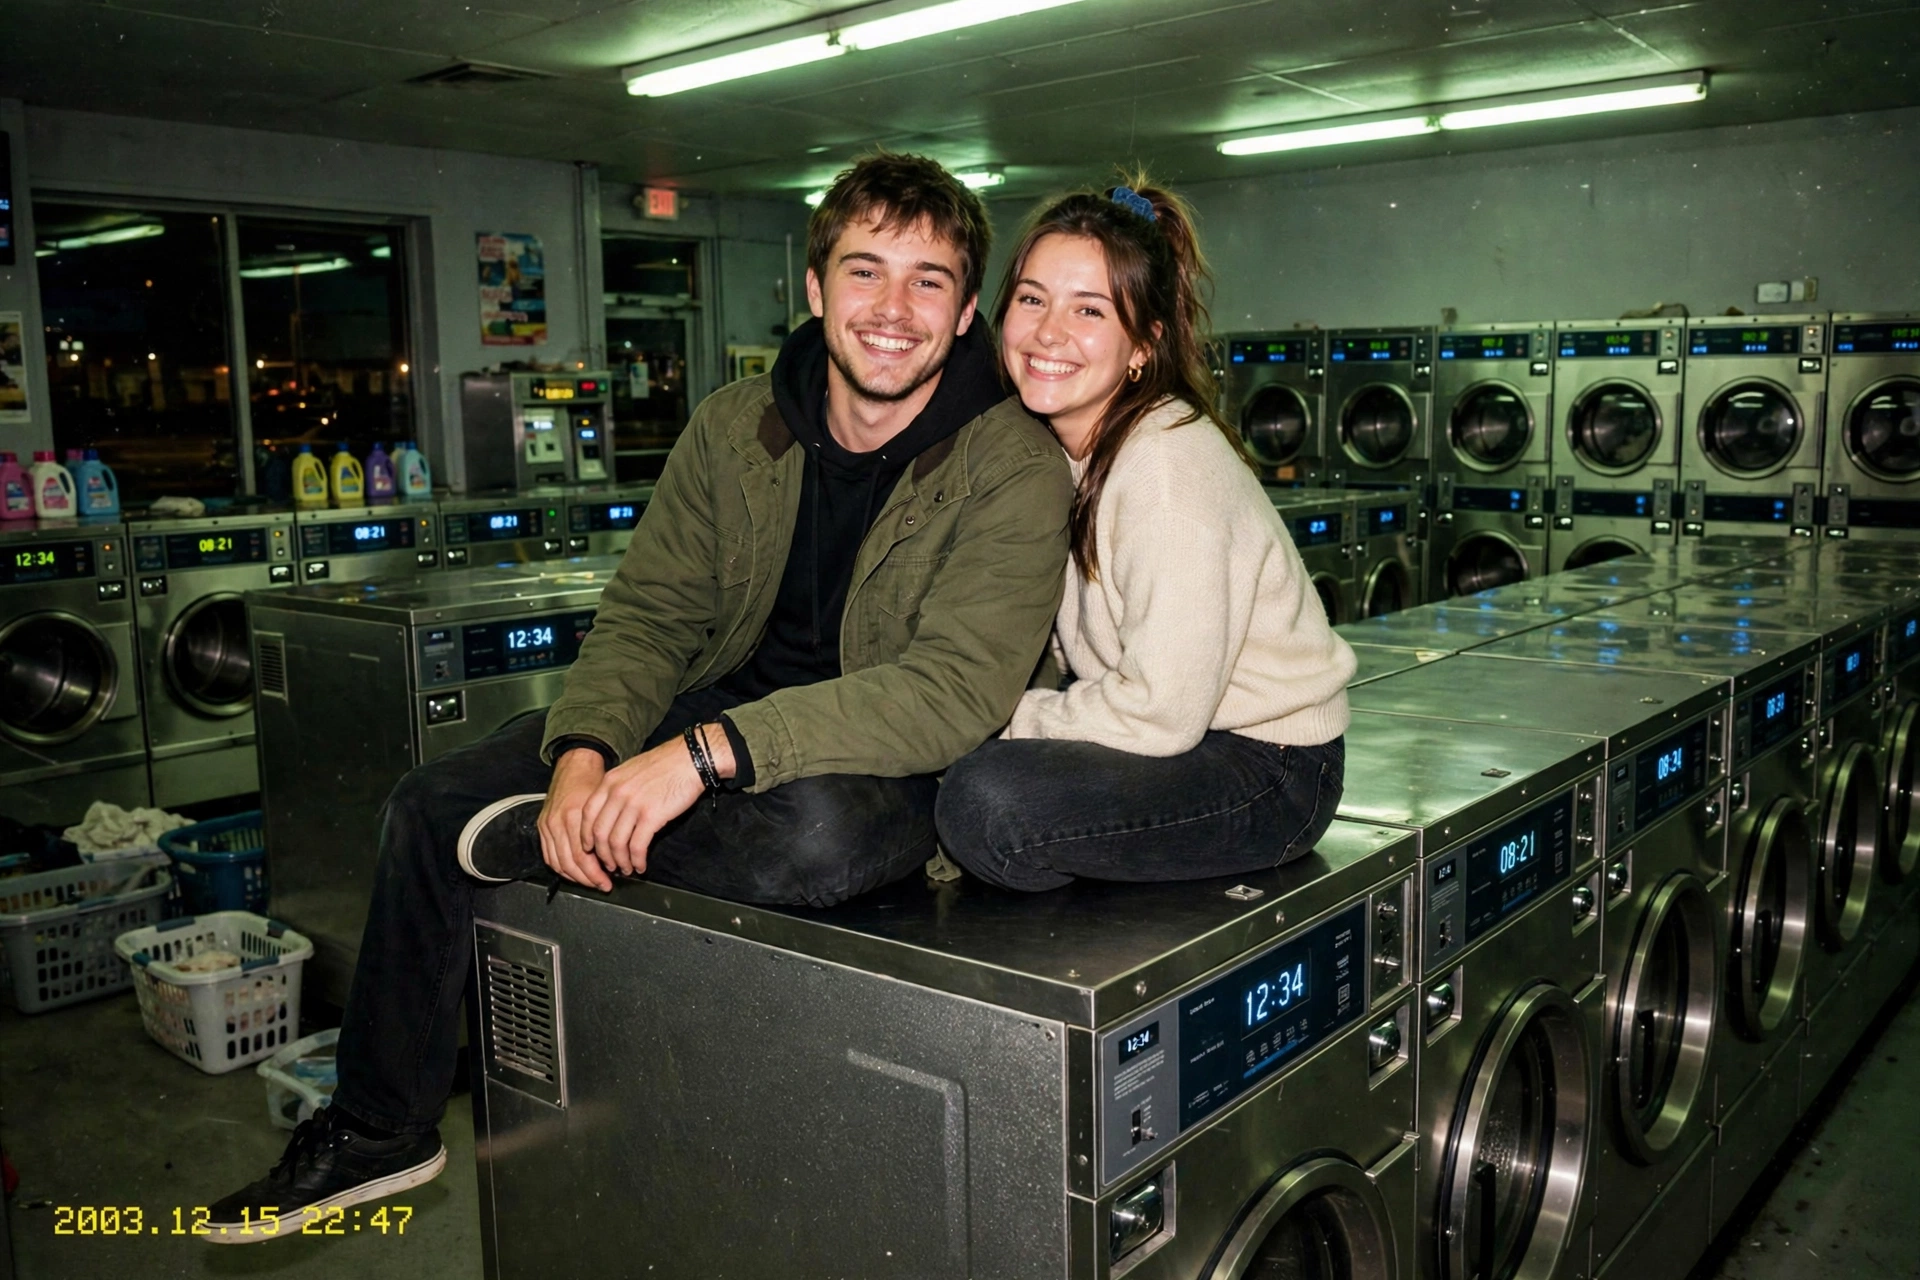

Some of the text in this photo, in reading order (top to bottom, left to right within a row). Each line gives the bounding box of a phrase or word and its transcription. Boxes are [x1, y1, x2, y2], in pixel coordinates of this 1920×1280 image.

[15, 551, 54, 567] 12:34
[507, 627, 552, 649] 12:34
[1500, 830, 1534, 873] 08:21
[1246, 963, 1304, 1026] 12:34
